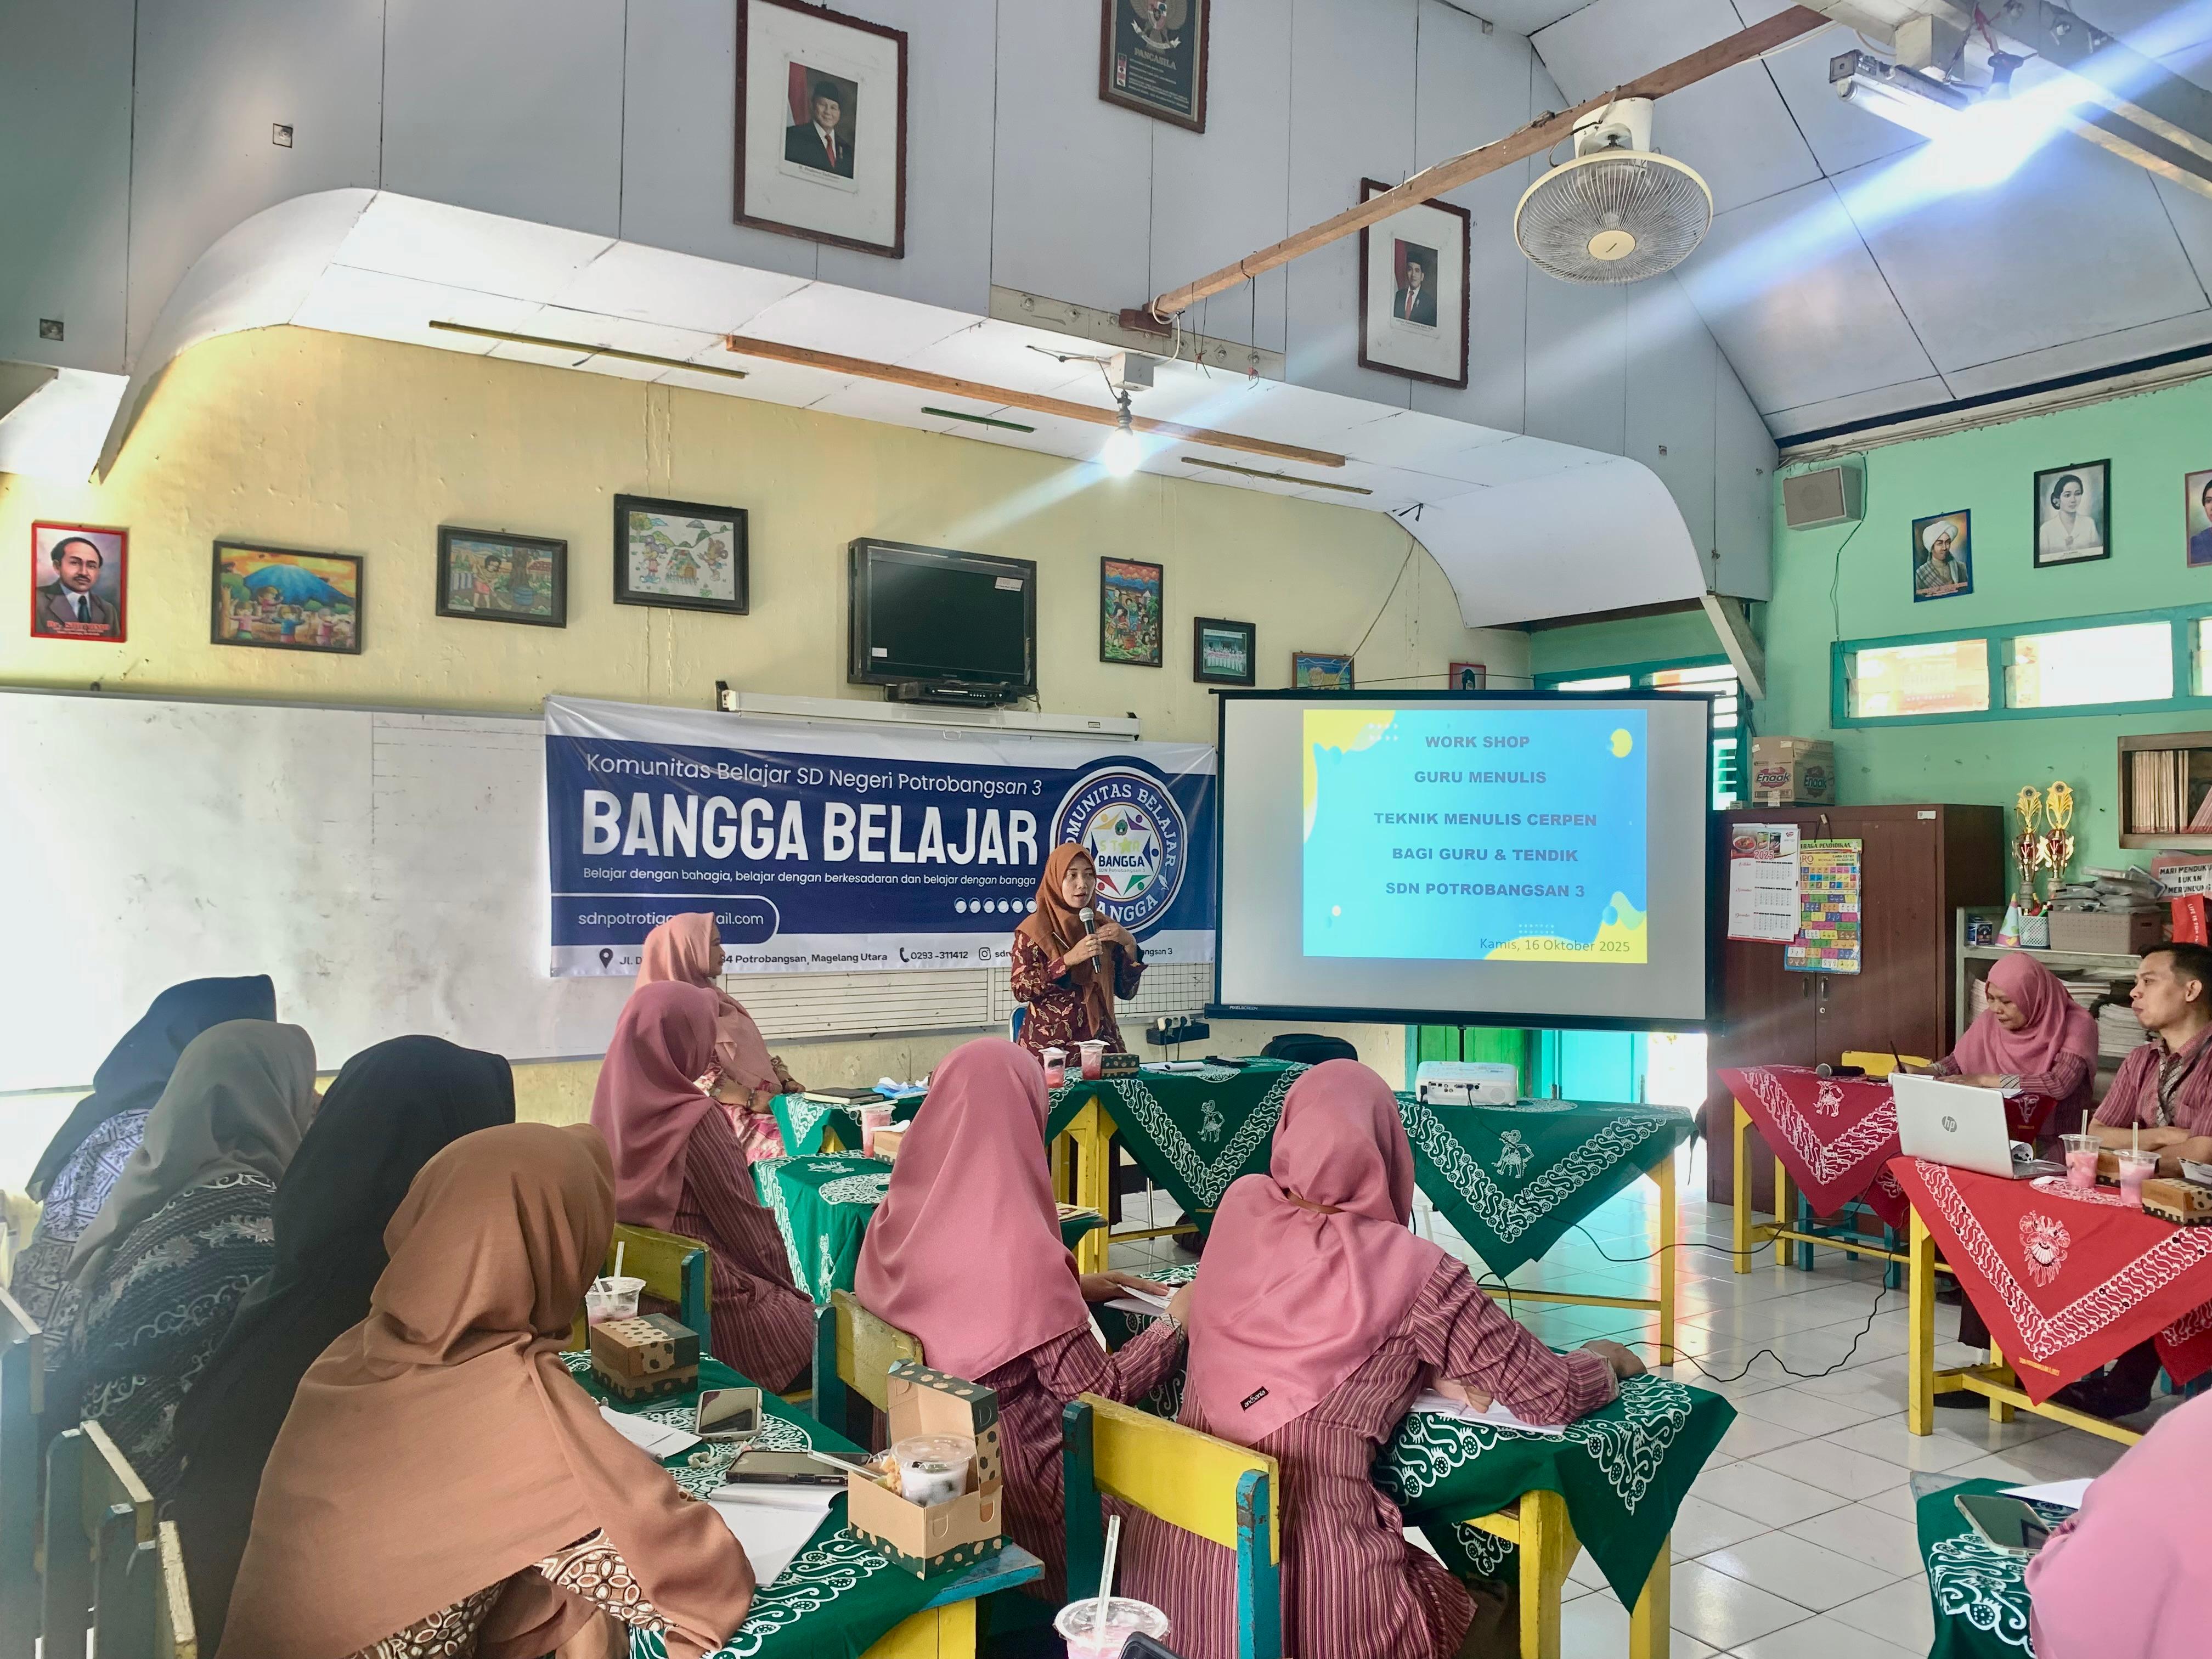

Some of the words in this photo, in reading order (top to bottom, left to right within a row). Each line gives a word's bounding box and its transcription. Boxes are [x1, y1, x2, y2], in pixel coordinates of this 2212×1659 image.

[1134, 48, 1177, 70] PANCASILA
[1425, 736, 1477, 748] WORK
[1483, 736, 1530, 748] SHOP
[587, 754, 711, 778] Komunitas
[718, 763, 791, 788] Belajar
[797, 768, 823, 785] SD
[830, 769, 893, 793] Negeri
[899, 773, 1027, 799] Potrobangsan
[1032, 780, 1042, 795] 3
[1414, 771, 1463, 783] GURU
[1469, 771, 1547, 783] MENULIS
[1757, 772, 1790, 782] Enaak
[1804, 775, 1826, 789] Enaak
[1065, 783, 1132, 843] OMUNITAS
[1137, 788, 1177, 867] BELAJAR
[1374, 812, 1438, 825] TEKNIK
[1444, 813, 1521, 825] MENULIS
[1527, 814, 1596, 826] CERPEN
[582, 789, 809, 860] BANGGA
[823, 802, 1038, 865] BELAJAR
[1099, 855, 1145, 867] BANGGA
[1392, 848, 1433, 860] BAGI
[1439, 849, 1488, 860] GURU
[1494, 849, 1506, 861] &
[1513, 849, 1578, 861] TENDIK
[1754, 850, 1774, 860] 2025
[584, 868, 626, 881] Belajar
[630, 868, 679, 882] dengan
[682, 870, 732, 884] bahagia,
[736, 871, 775, 884] belajar
[778, 872, 821, 885] dengan
[825, 873, 899, 883] berkesadaran
[901, 874, 921, 884] dan
[924, 874, 958, 887] belajar
[961, 875, 997, 887] dengan
[999, 876, 1036, 887] bangga
[1386, 883, 1420, 894] SDN
[1426, 883, 1569, 897] POTROBANGSAN
[1575, 885, 1584, 897] 3
[1097, 894, 1159, 922] ANGGA
[1480, 939, 1520, 952] Kamis,
[1525, 939, 1540, 951] 16
[1544, 939, 1595, 952] Oktober
[1599, 941, 1630, 952] 2025
[736, 955, 809, 965] Potrobangsan,
[812, 954, 859, 963] Magelang
[861, 953, 888, 961] Utara
[1943, 1115, 1956, 1132] hp
